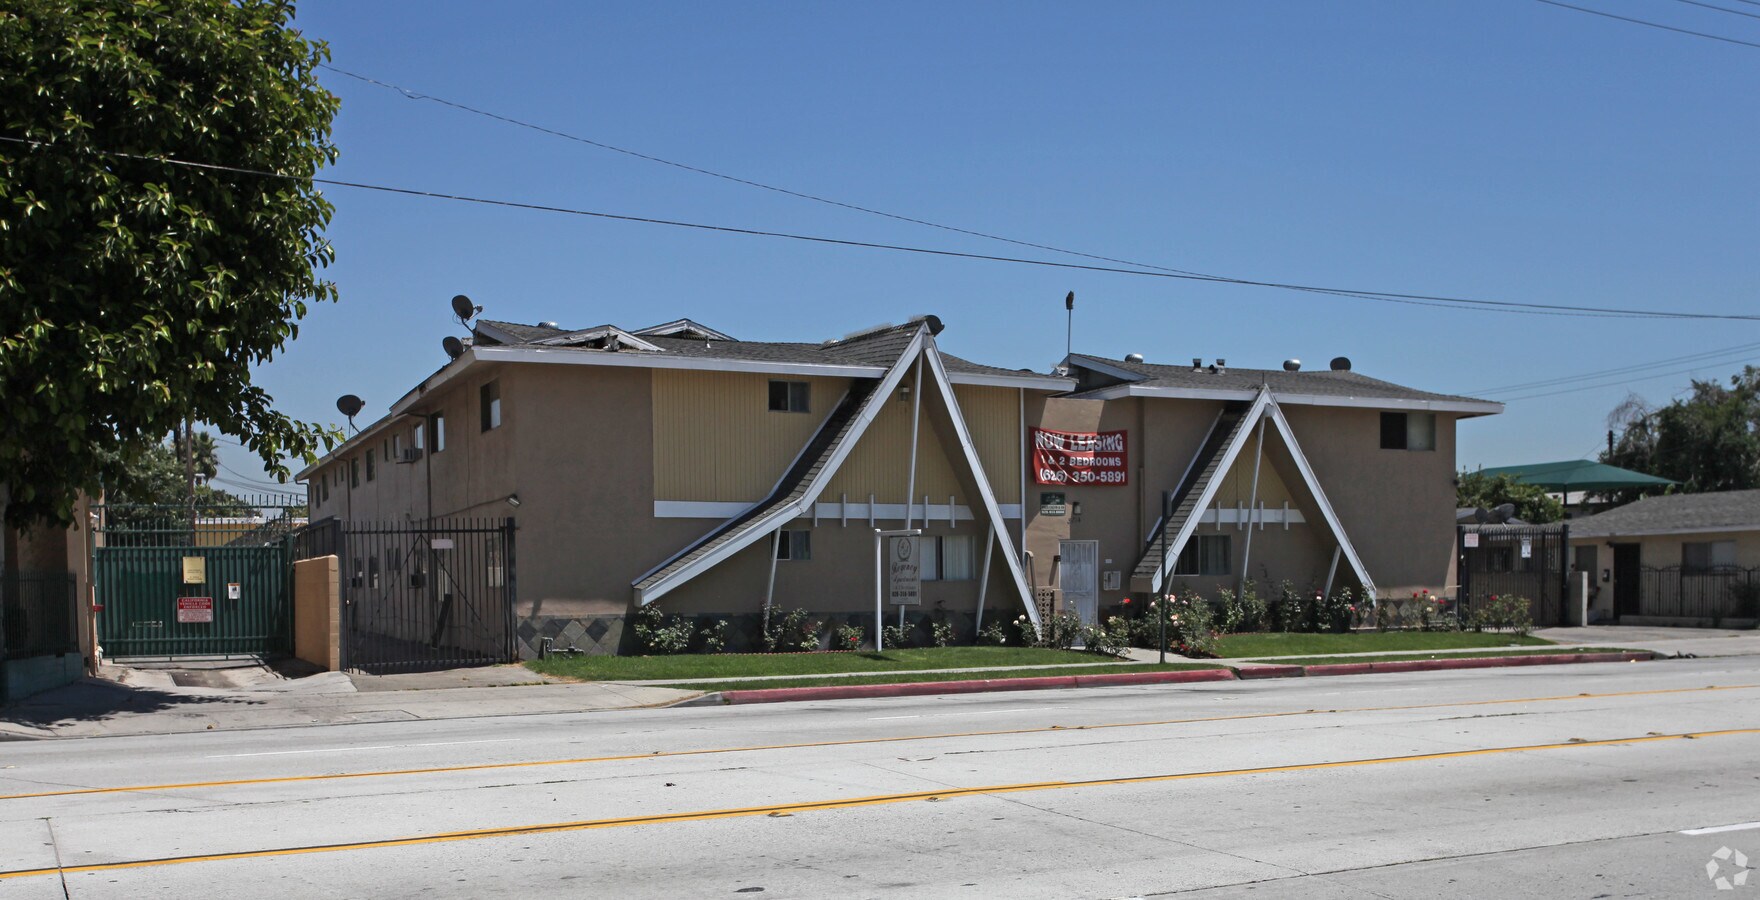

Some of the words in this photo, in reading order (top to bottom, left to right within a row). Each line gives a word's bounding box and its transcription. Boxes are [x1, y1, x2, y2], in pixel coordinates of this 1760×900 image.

[1034, 430, 1065, 450] NOW
[1070, 433, 1124, 451] LEASING
[1048, 455, 1055, 465] &
[1059, 456, 1065, 466] 2
[1069, 456, 1122, 467] BEDROOMS
[1040, 468, 1068, 482] (626)
[1072, 470, 1126, 483] 350-5891
